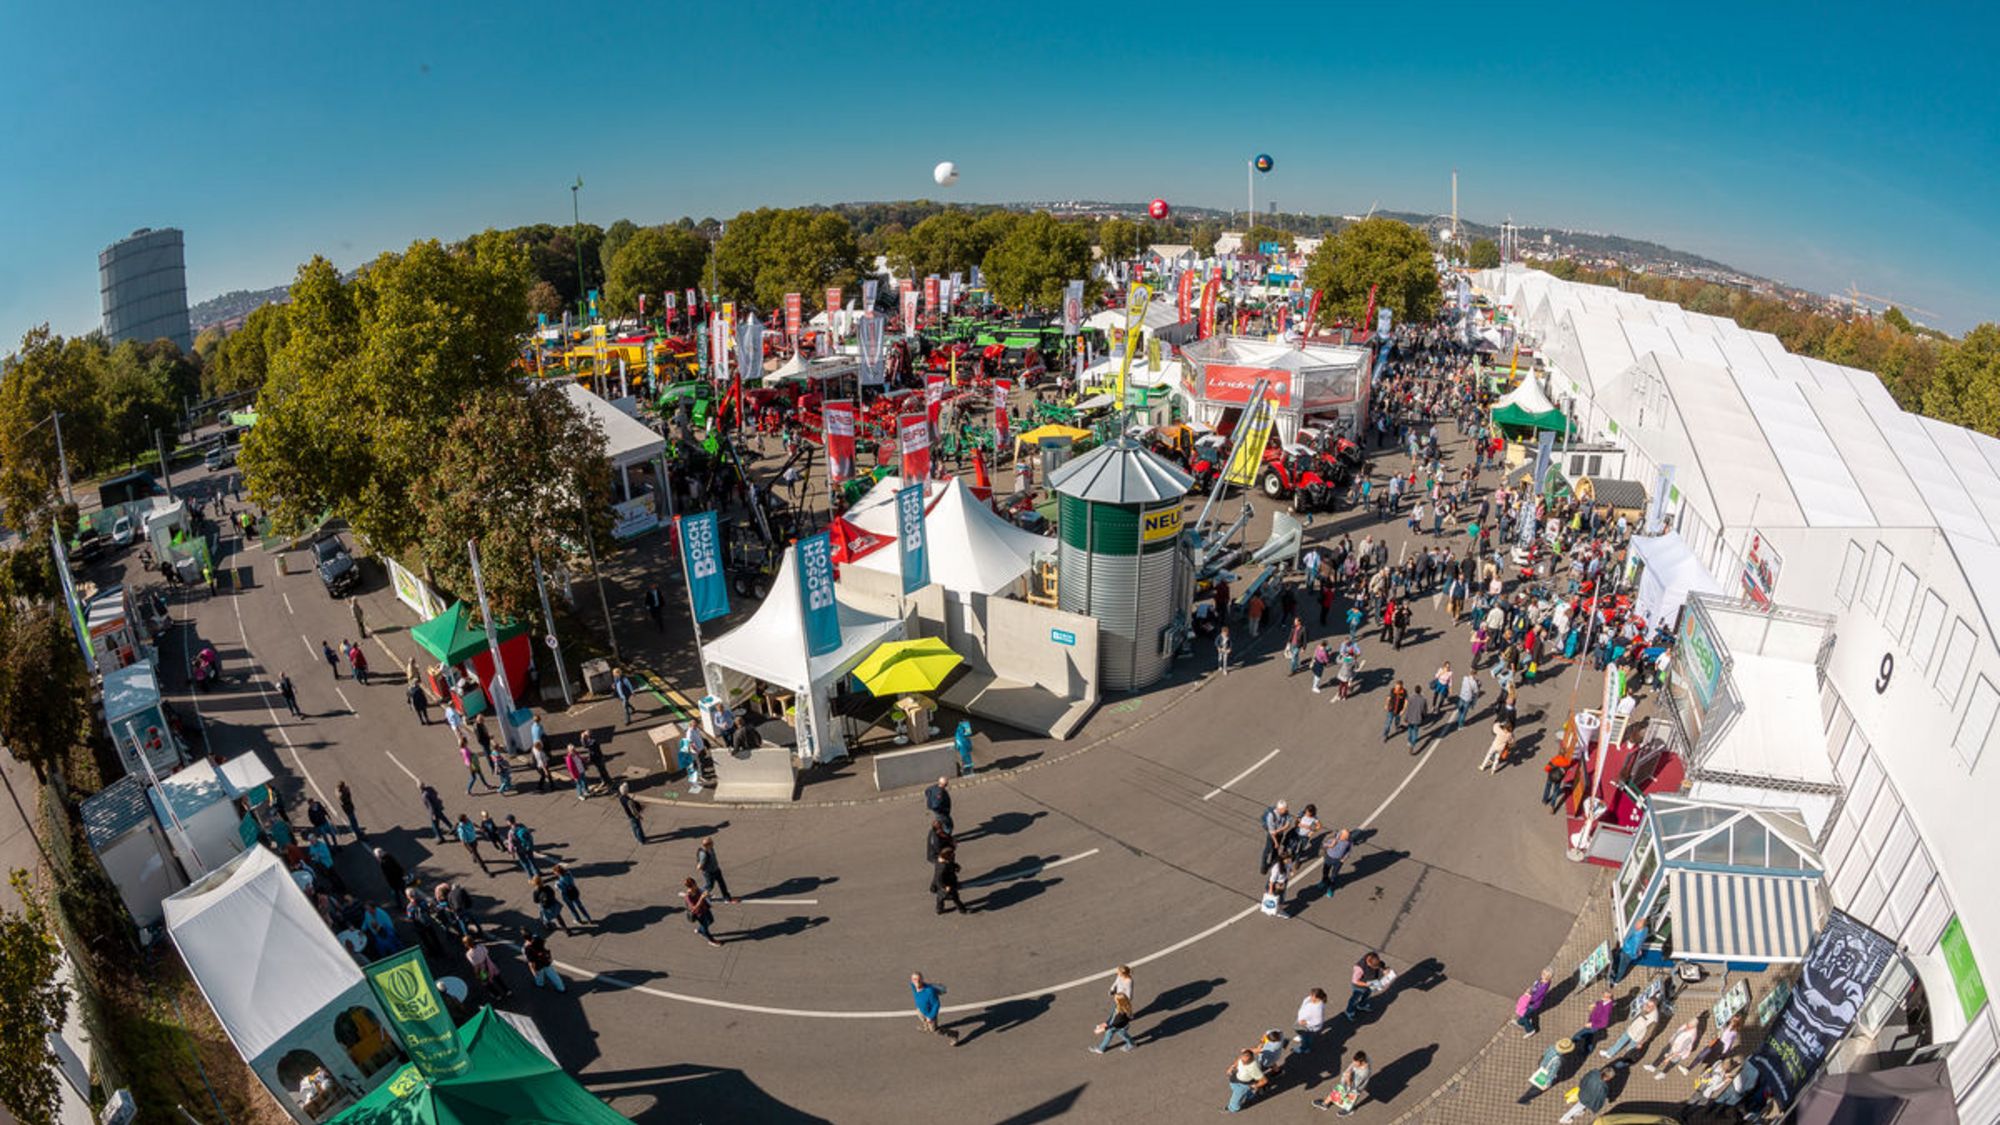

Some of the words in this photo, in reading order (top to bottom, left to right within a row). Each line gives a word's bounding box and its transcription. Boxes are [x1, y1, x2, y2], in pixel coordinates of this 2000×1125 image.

[1208, 378, 1272, 390] Lindn
[688, 520, 706, 579] BOSCH
[700, 518, 717, 577] BETON
[1145, 511, 1180, 531] NEU
[803, 543, 822, 611] BOSCH
[814, 540, 834, 607] BETON
[1875, 652, 1894, 695] 9
